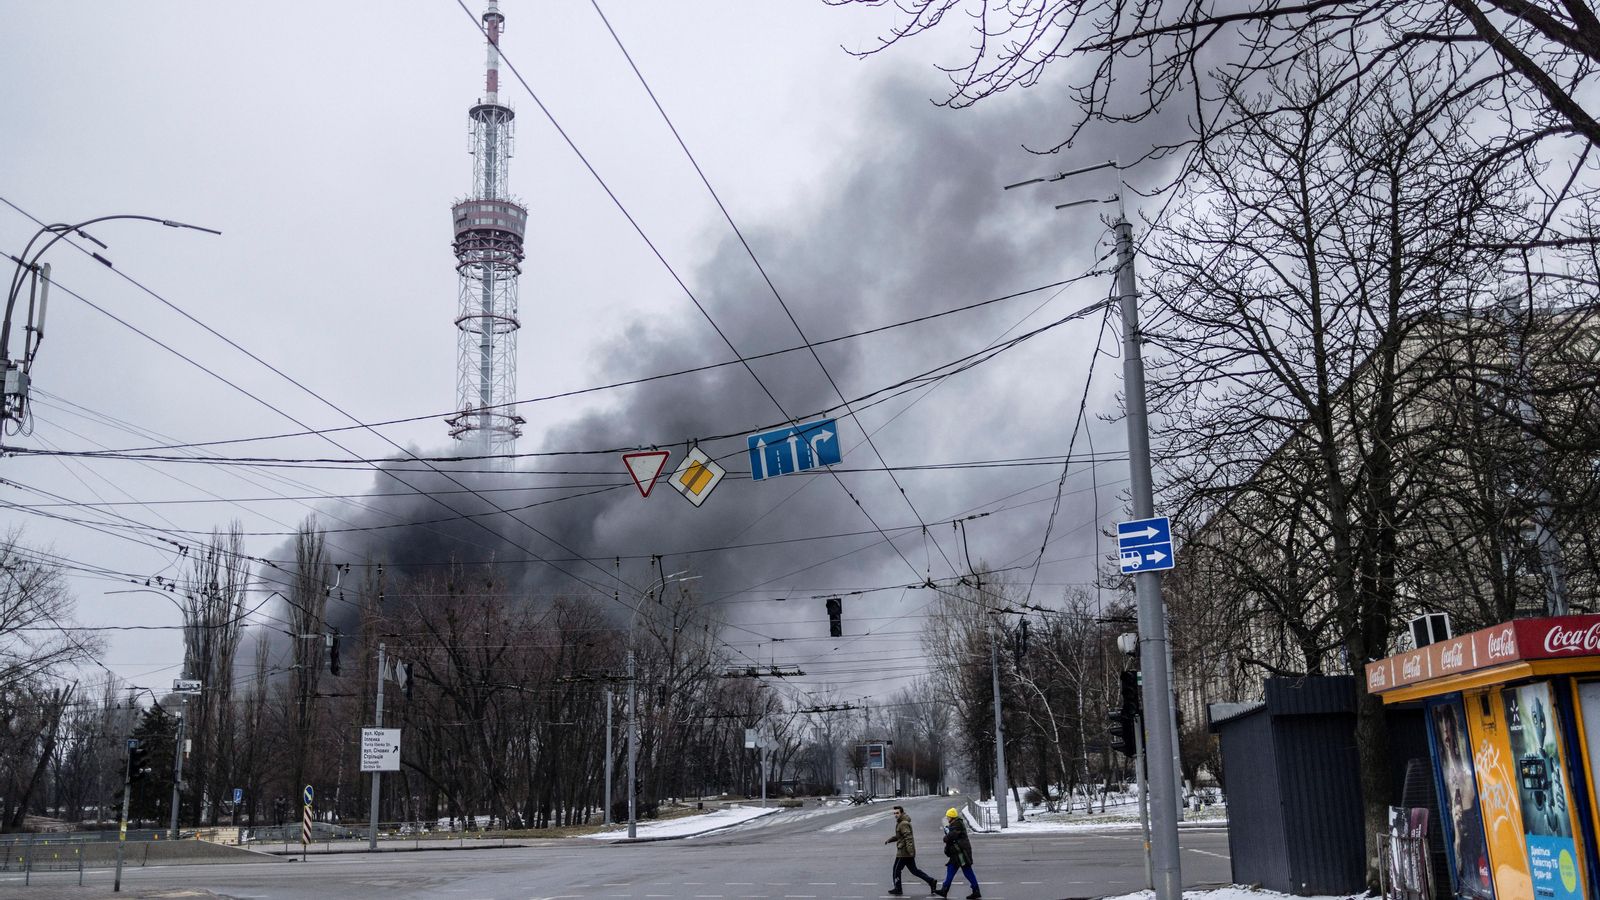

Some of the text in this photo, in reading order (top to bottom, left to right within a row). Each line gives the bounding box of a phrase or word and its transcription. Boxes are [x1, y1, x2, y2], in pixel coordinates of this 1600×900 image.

[1488, 628, 1515, 659] Coca-Cola
[1544, 622, 1600, 653] Coca-C
[1441, 642, 1463, 670] Coca-Cola
